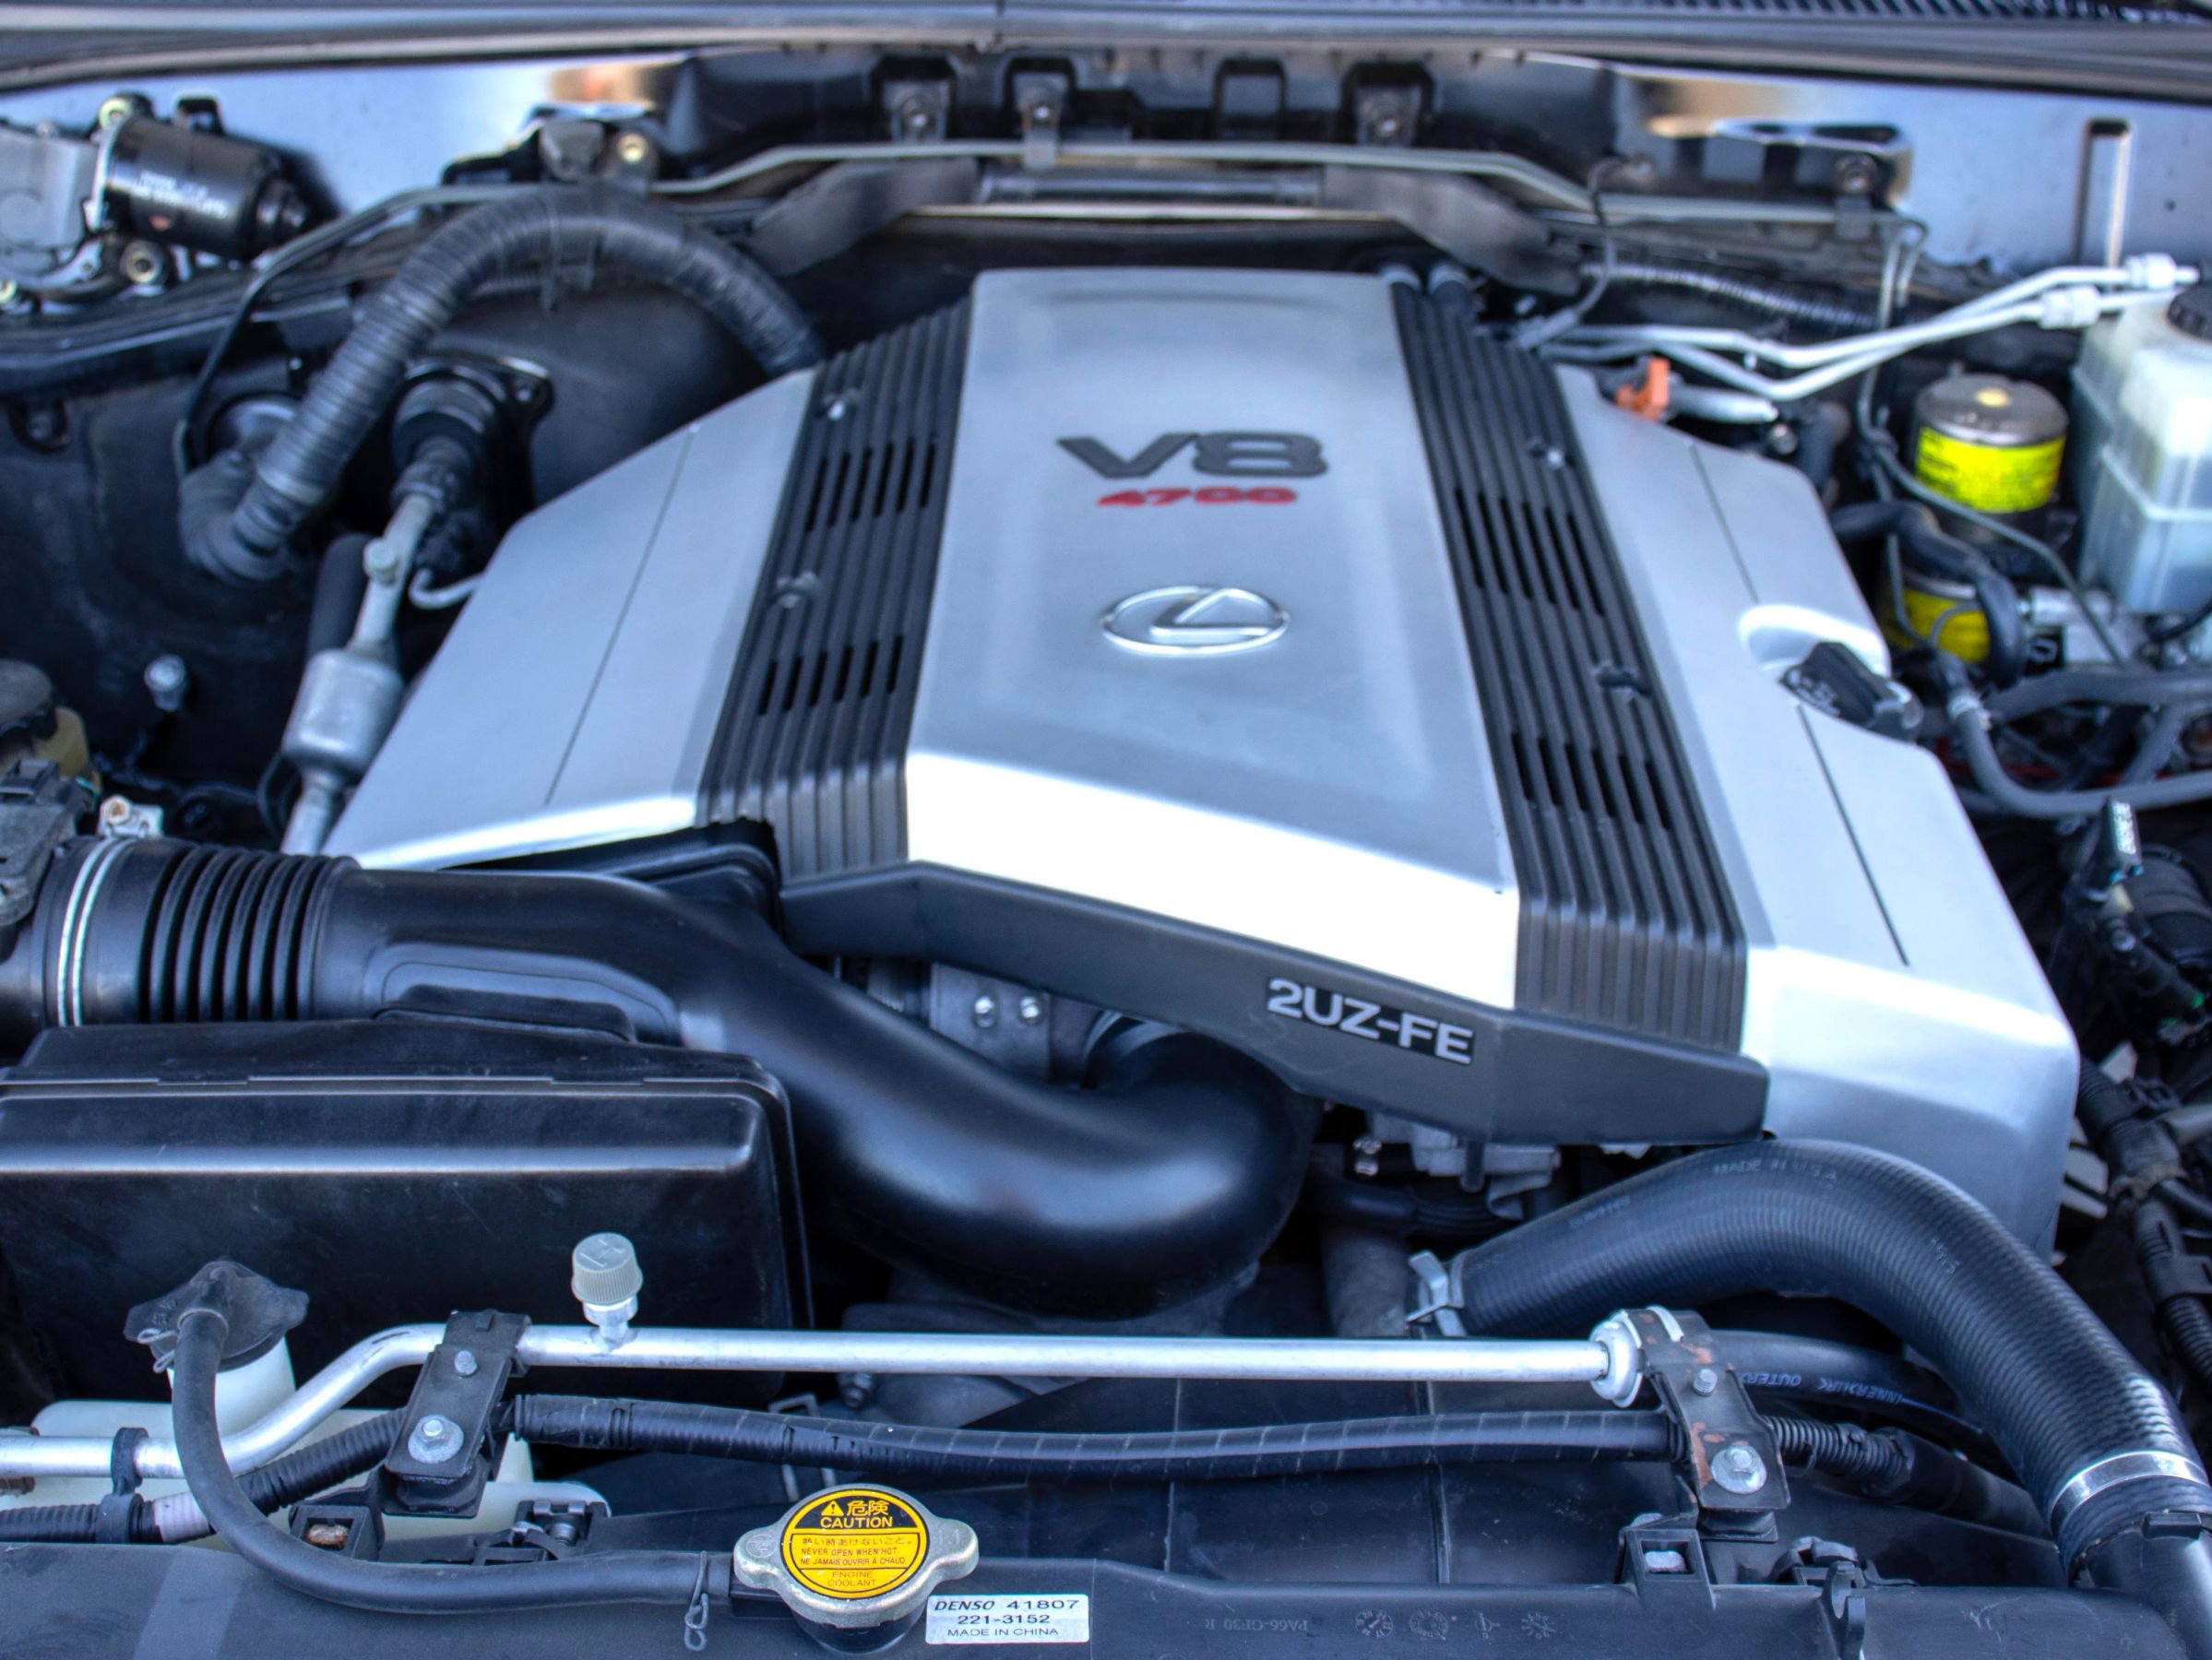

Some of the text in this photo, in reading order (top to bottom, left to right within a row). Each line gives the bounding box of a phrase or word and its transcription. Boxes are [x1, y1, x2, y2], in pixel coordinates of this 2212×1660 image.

[1056, 430, 1329, 480] V8
[1097, 486, 1298, 507] 4700
[1267, 978, 1474, 1064] 2UZ-FE
[847, 1500, 890, 1517] 危険
[820, 1516, 894, 1528] CAUTION
[881, 1547, 898, 1555] HOT
[934, 1600, 1080, 1611] DENSO 41807
[957, 1615, 1051, 1625] 221-3152
[947, 1628, 1059, 1637] MADE IN CHINA
